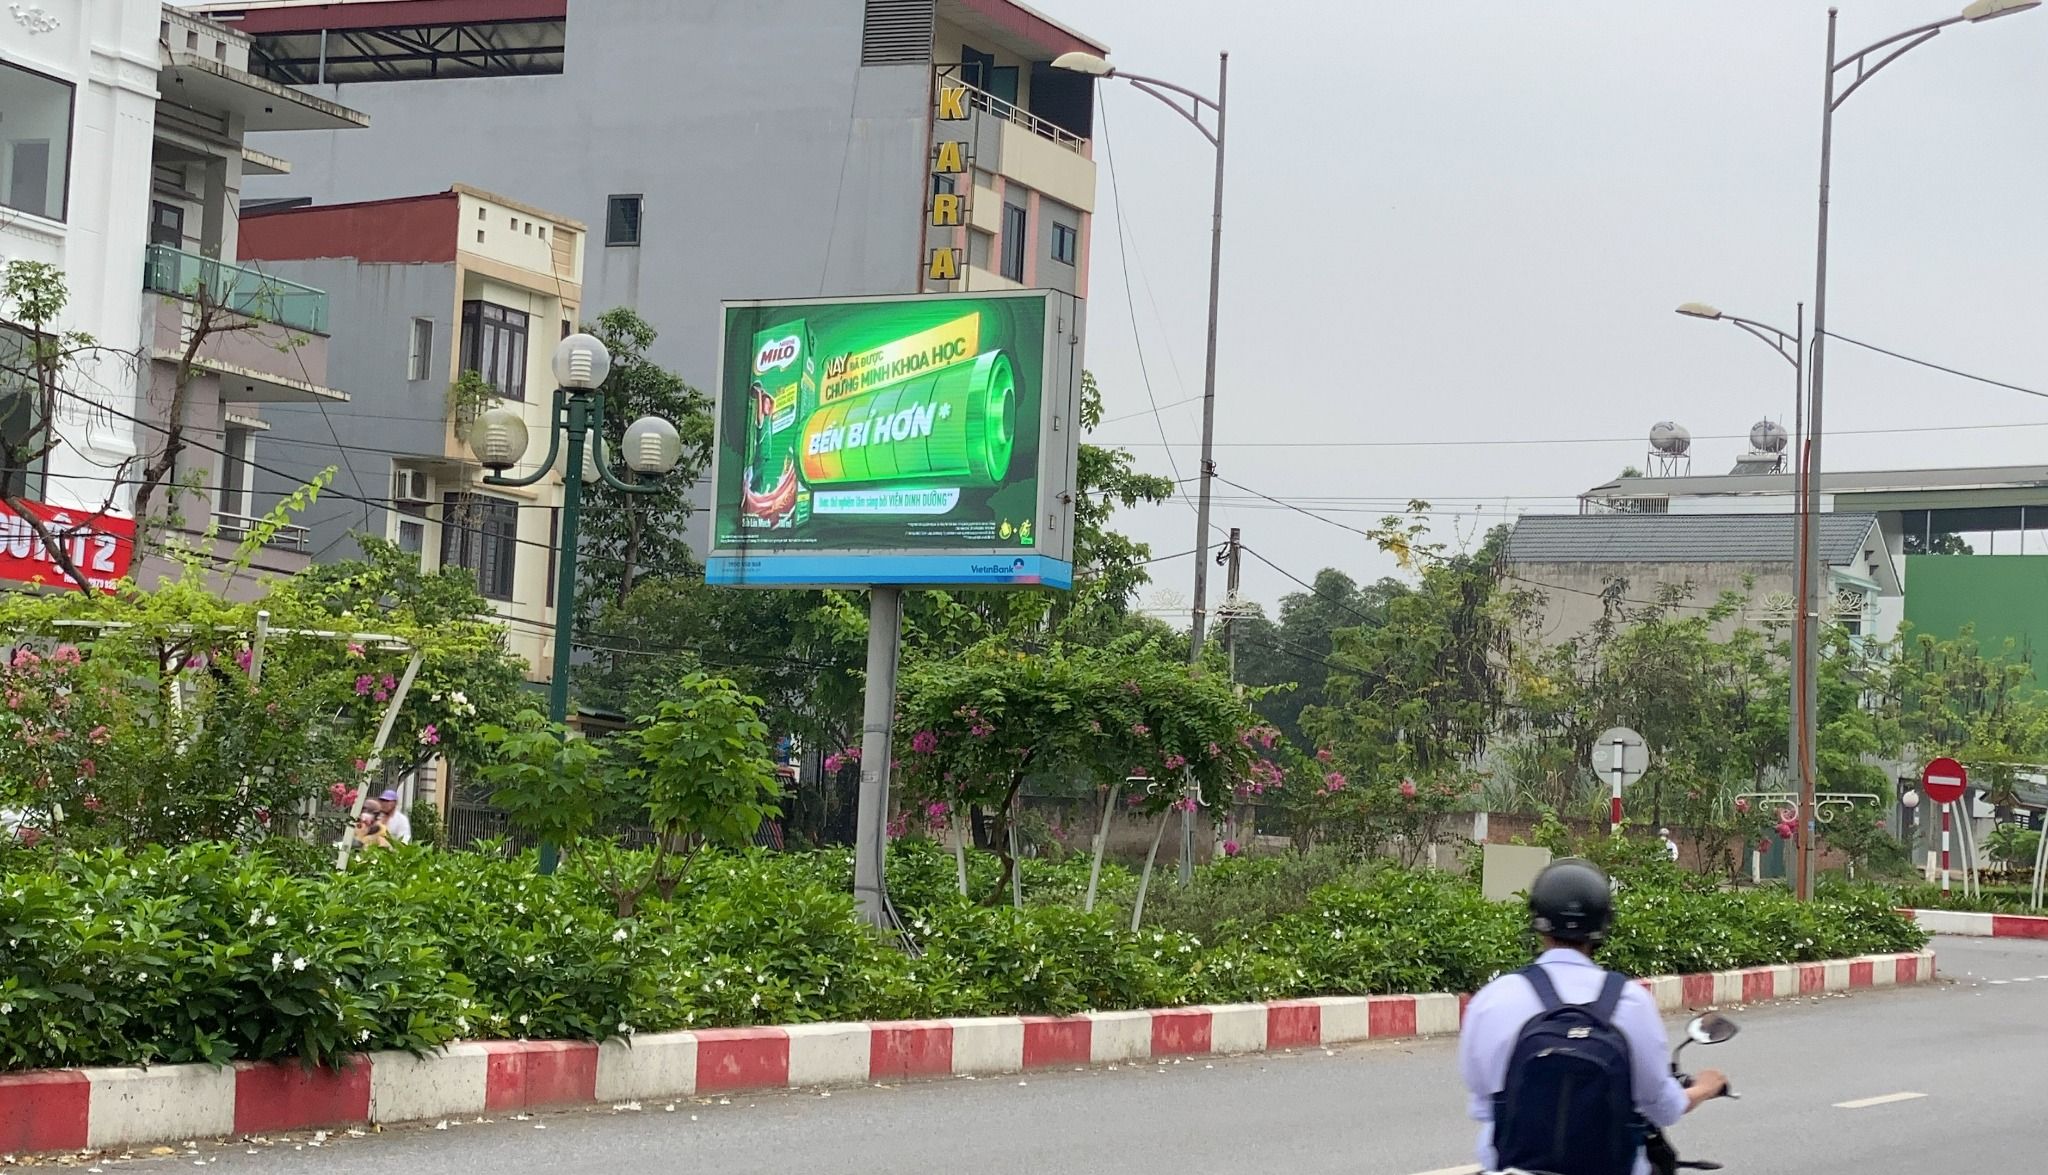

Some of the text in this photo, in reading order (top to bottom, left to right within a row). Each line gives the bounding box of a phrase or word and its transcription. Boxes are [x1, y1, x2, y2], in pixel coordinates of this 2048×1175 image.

[929, 87, 967, 280] KARA
[760, 345, 795, 366] MILO
[825, 375, 859, 400] CHỨNG
[861, 362, 890, 389] MINH
[891, 350, 930, 378] KHOA
[931, 337, 966, 365] HỌC
[826, 352, 851, 379] NAY
[92, 532, 117, 573] 2
[971, 564, 1014, 574] VietinBank
